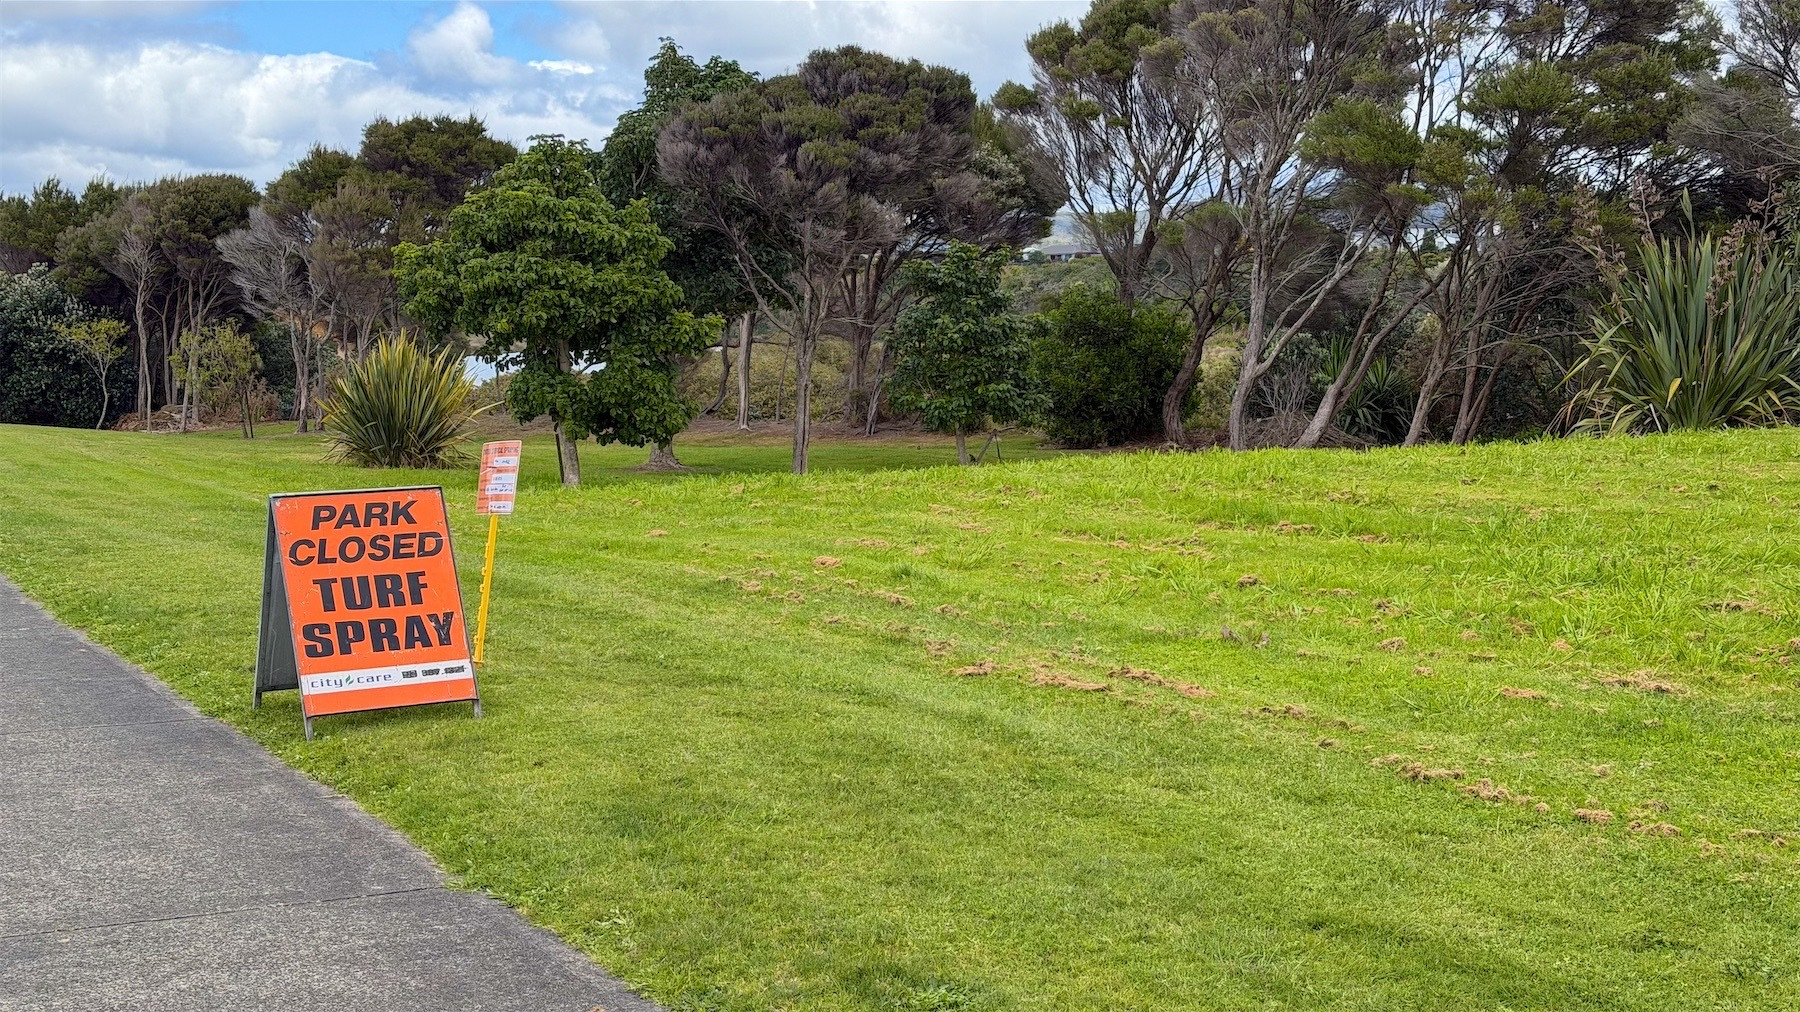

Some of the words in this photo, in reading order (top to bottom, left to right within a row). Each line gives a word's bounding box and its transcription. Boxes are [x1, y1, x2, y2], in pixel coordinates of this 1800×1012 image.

[311, 500, 417, 530] PARK
[288, 532, 443, 566] CLOSED
[313, 571, 428, 612] TURF
[302, 612, 454, 658] SPRAY
[311, 677, 343, 688] city
[357, 673, 392, 684] care
